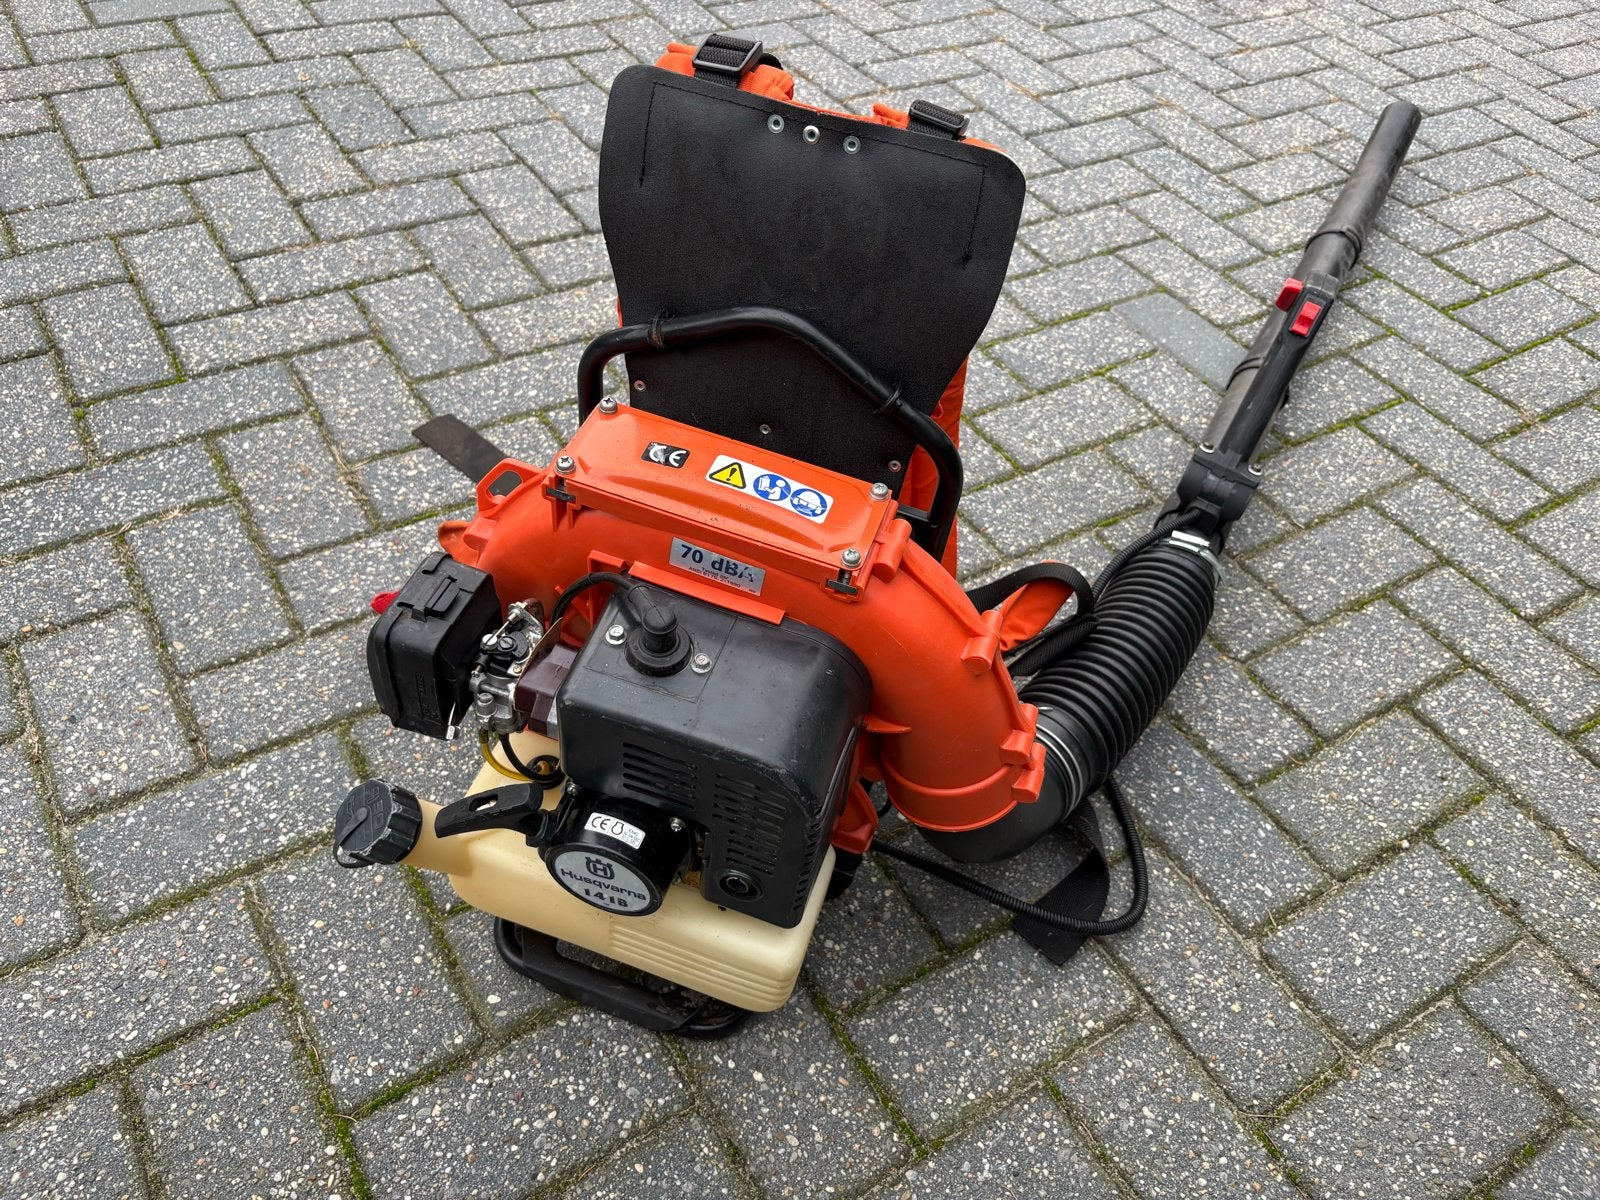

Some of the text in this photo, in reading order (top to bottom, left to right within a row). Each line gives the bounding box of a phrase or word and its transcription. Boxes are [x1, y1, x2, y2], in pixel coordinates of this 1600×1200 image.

[649, 445, 687, 467] CE
[681, 544, 703, 564] 70
[592, 816, 611, 831] CE
[561, 868, 646, 900] Husqvarna
[584, 888, 628, 907] 141B
